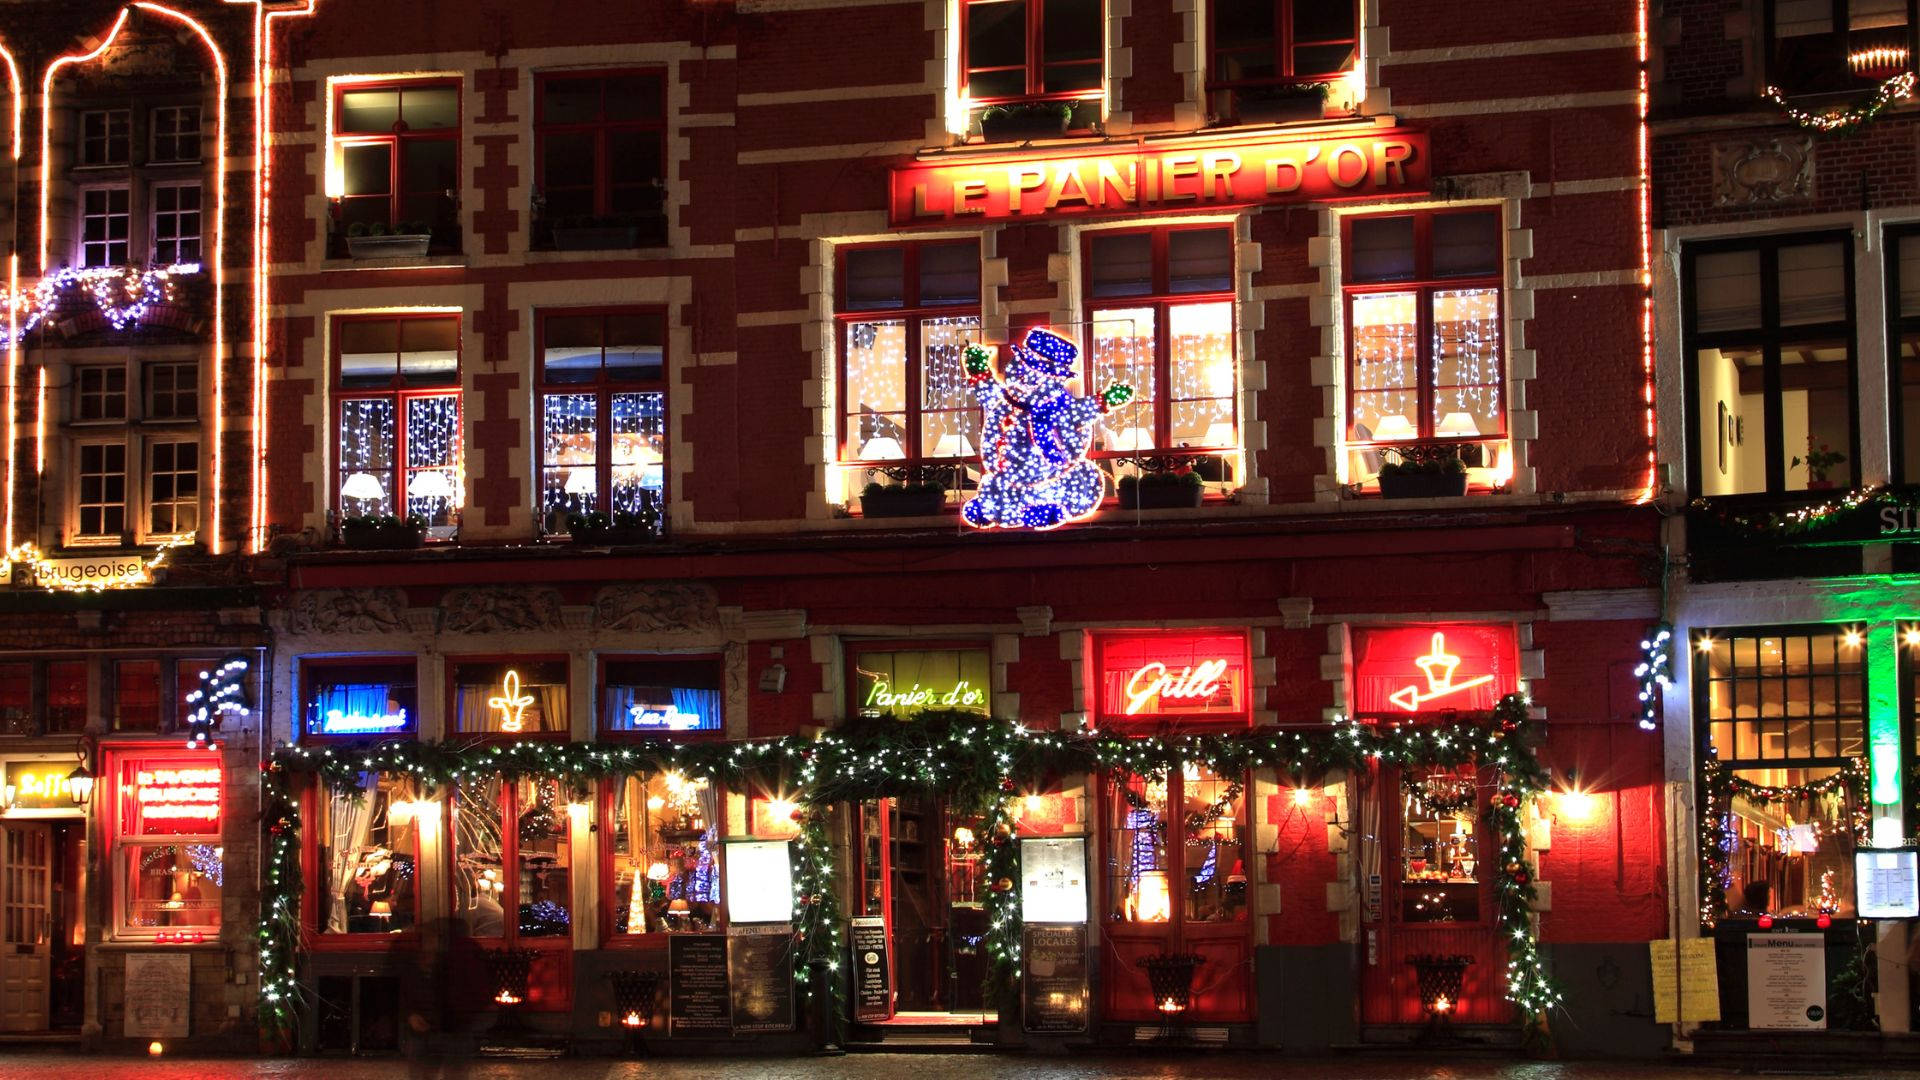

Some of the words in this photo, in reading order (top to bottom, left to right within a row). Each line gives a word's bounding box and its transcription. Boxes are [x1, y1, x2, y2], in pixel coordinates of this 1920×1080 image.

[915, 180, 988, 217] LE
[1008, 151, 1242, 211] PANIER
[1265, 140, 1414, 195] D'OR
[1879, 506, 1920, 534] SI
[866, 681, 936, 706] Panier
[942, 681, 985, 706] d'or
[1125, 658, 1228, 716] Grill
[1032, 937, 1078, 946] LOCALES
[1767, 939, 1795, 948] Menu
